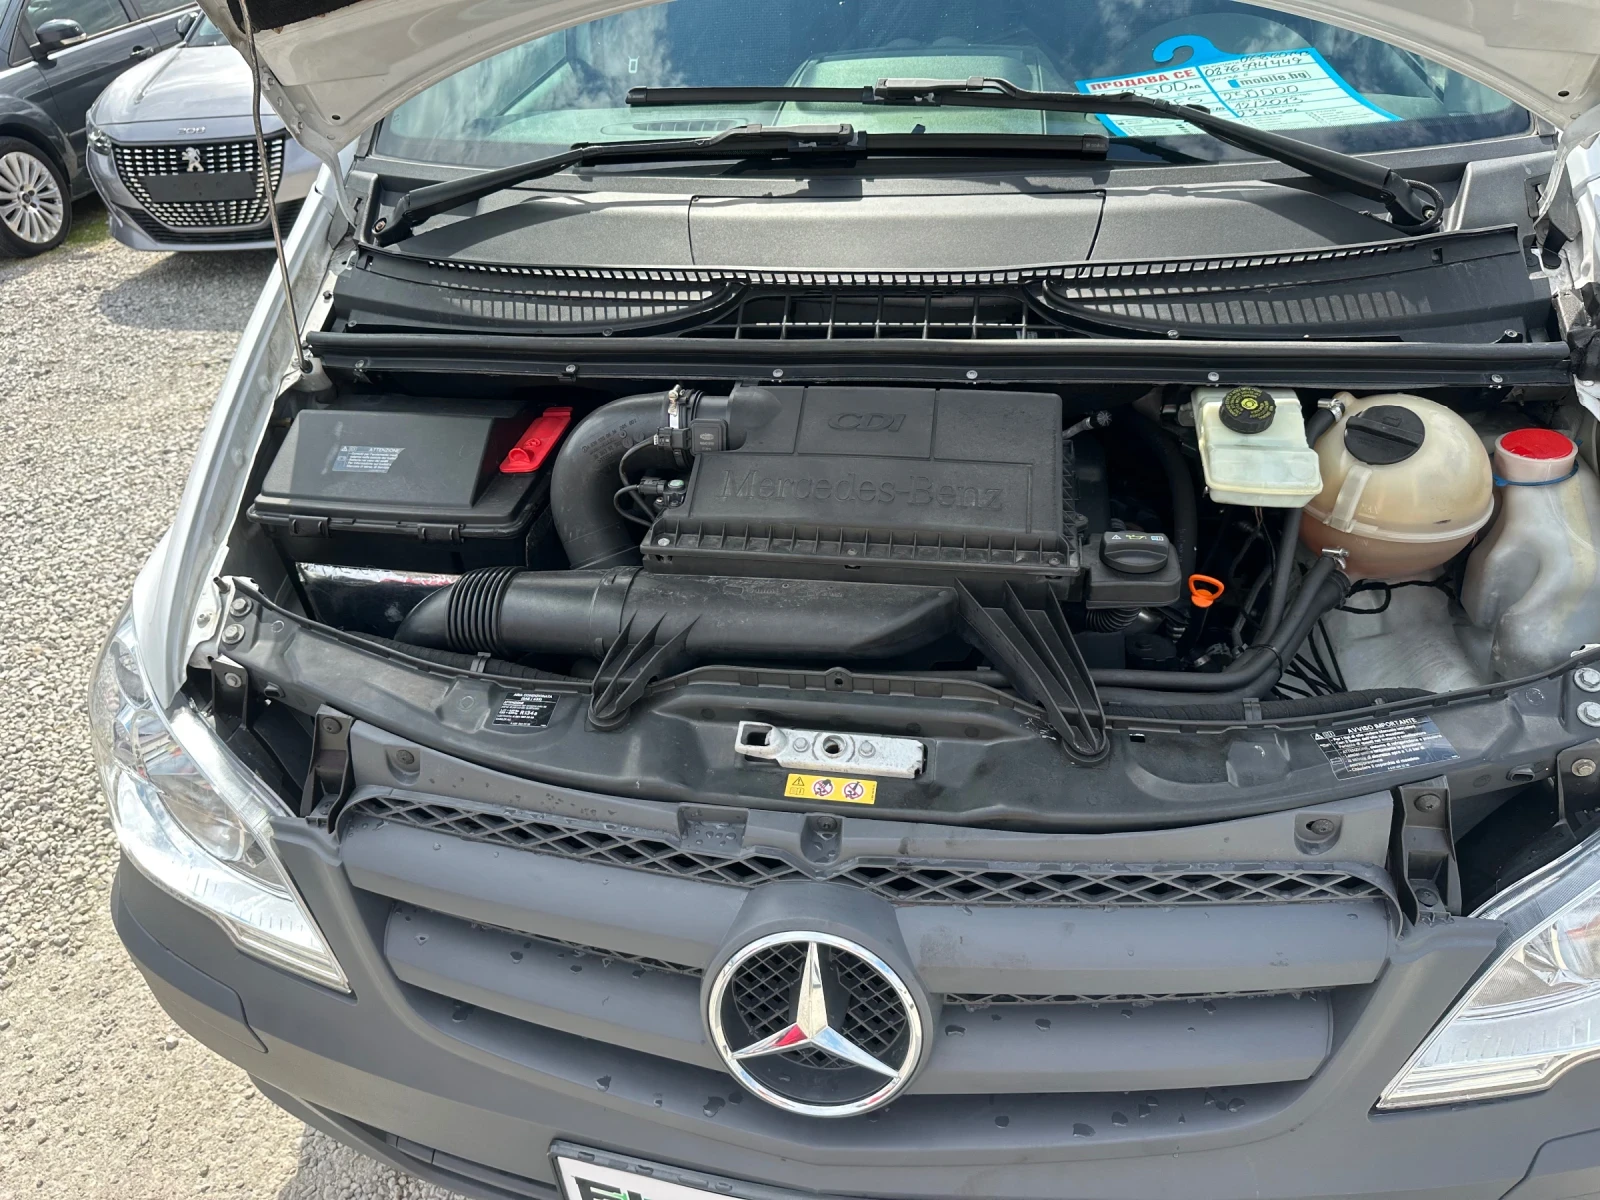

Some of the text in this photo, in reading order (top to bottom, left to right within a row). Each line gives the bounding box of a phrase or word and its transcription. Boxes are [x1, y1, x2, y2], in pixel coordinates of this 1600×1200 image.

[1090, 74, 1170, 91] ПРОДАВА
[1173, 69, 1196, 79] СЕ
[1239, 71, 1308, 86] mobile.bg
[177, 126, 206, 136] 208
[827, 412, 906, 433] CDI
[715, 469, 1003, 511] Mercedes-Benz
[1347, 717, 1418, 734] AVVISO IMPORTANTE
